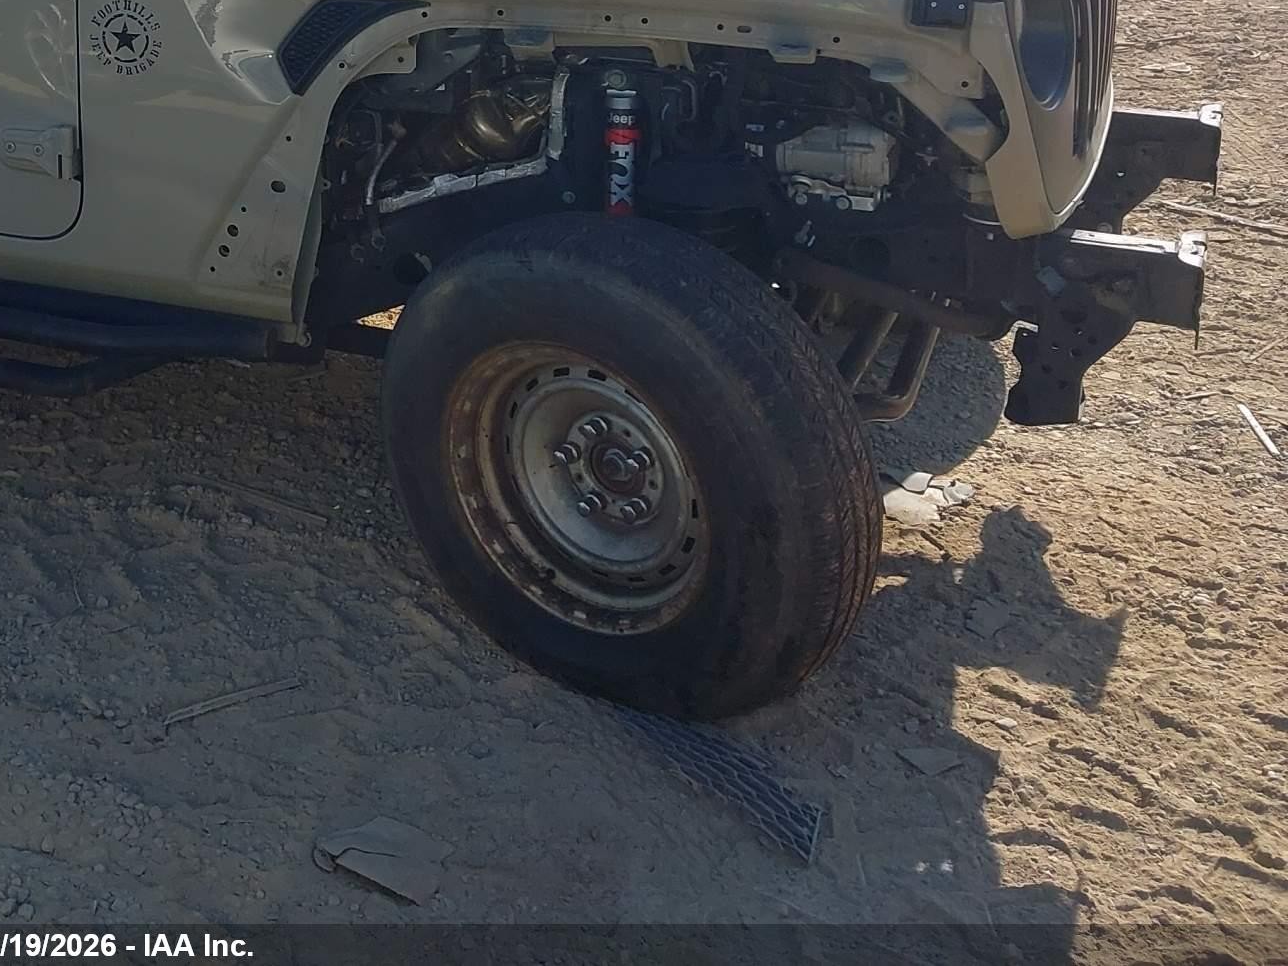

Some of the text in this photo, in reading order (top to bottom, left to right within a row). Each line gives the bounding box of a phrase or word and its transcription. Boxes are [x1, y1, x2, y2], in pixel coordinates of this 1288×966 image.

[91, 0, 161, 32] FOOTHILLS
[89, 34, 163, 75] JEEP BRIGADE
[608, 112, 635, 126] Jeep
